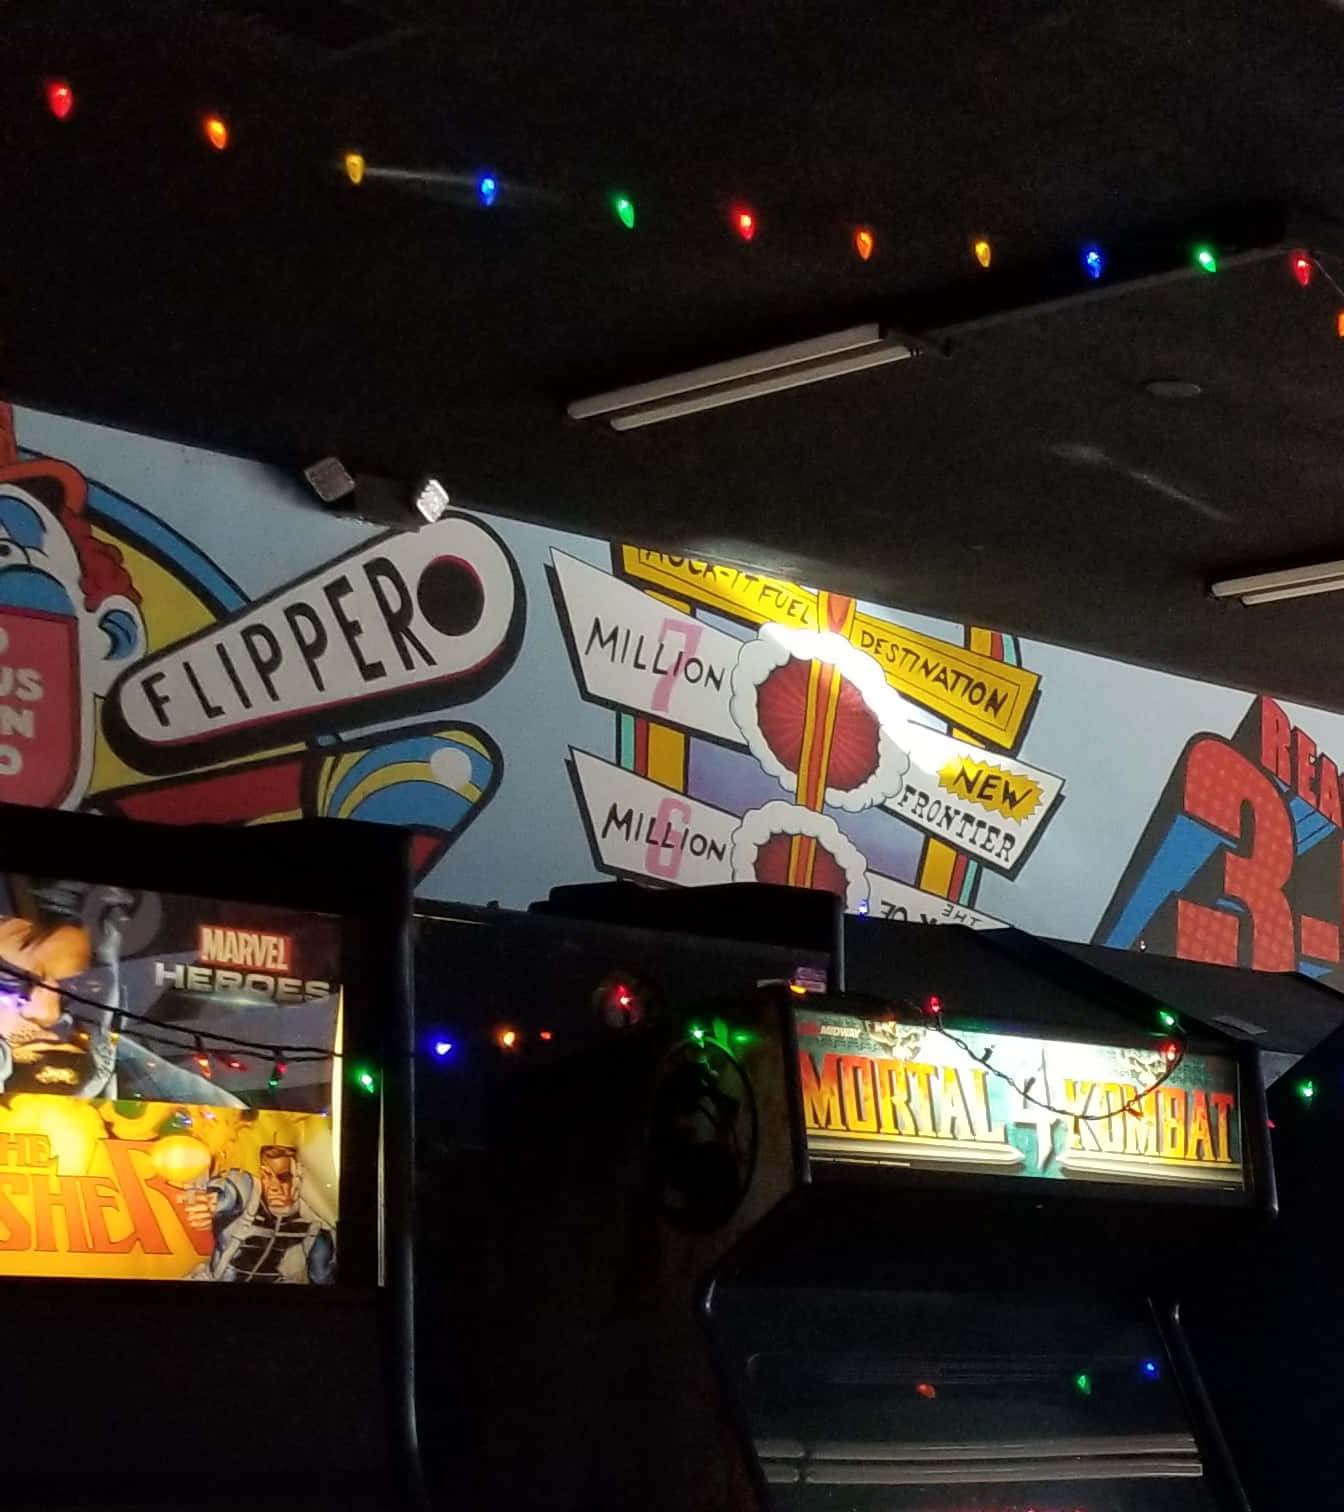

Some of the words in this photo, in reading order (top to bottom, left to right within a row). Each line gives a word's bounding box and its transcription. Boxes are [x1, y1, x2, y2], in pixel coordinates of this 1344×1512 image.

[140, 556, 438, 727] FLIPPER
[759, 584, 809, 624] FUEL
[585, 616, 725, 691] MILLION
[651, 617, 704, 713] 7
[861, 630, 1009, 718] DESTINATION
[897, 783, 1018, 863] FRONTIER
[952, 765, 1033, 811] NEW
[602, 801, 727, 862] MILLION
[645, 797, 693, 879] 6
[155, 961, 331, 1002] HEROES
[201, 926, 290, 971] MARVEL
[798, 1050, 1008, 1144] MORTAL
[1063, 1077, 1236, 1164] KOMBAT
